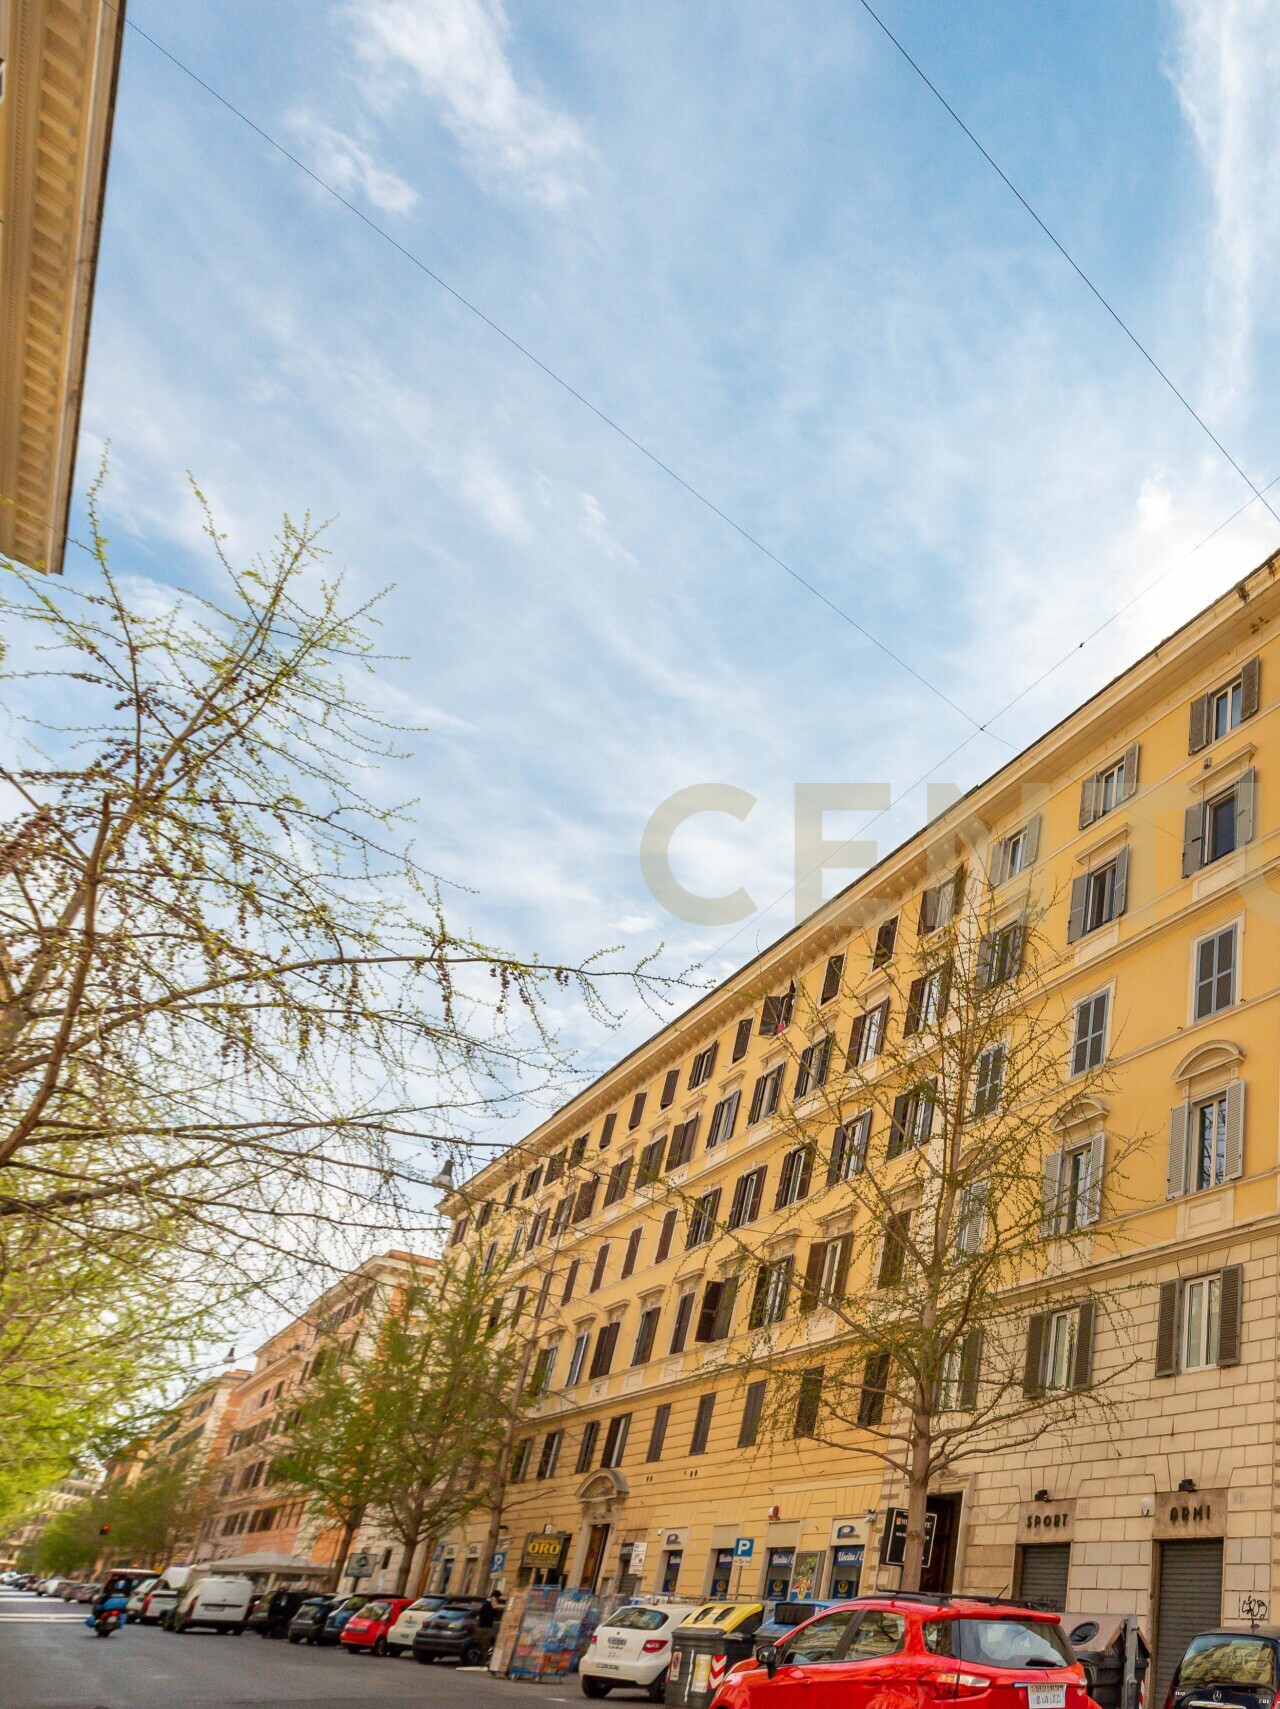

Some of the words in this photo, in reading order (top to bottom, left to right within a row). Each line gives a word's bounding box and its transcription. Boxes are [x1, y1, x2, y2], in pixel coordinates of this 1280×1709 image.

[1026, 1513, 1068, 1528] SPORT
[1169, 1505, 1212, 1522] ARMI
[527, 1542, 560, 1555] ORO
[737, 1540, 751, 1555] P
[494, 1555, 503, 1569] P
